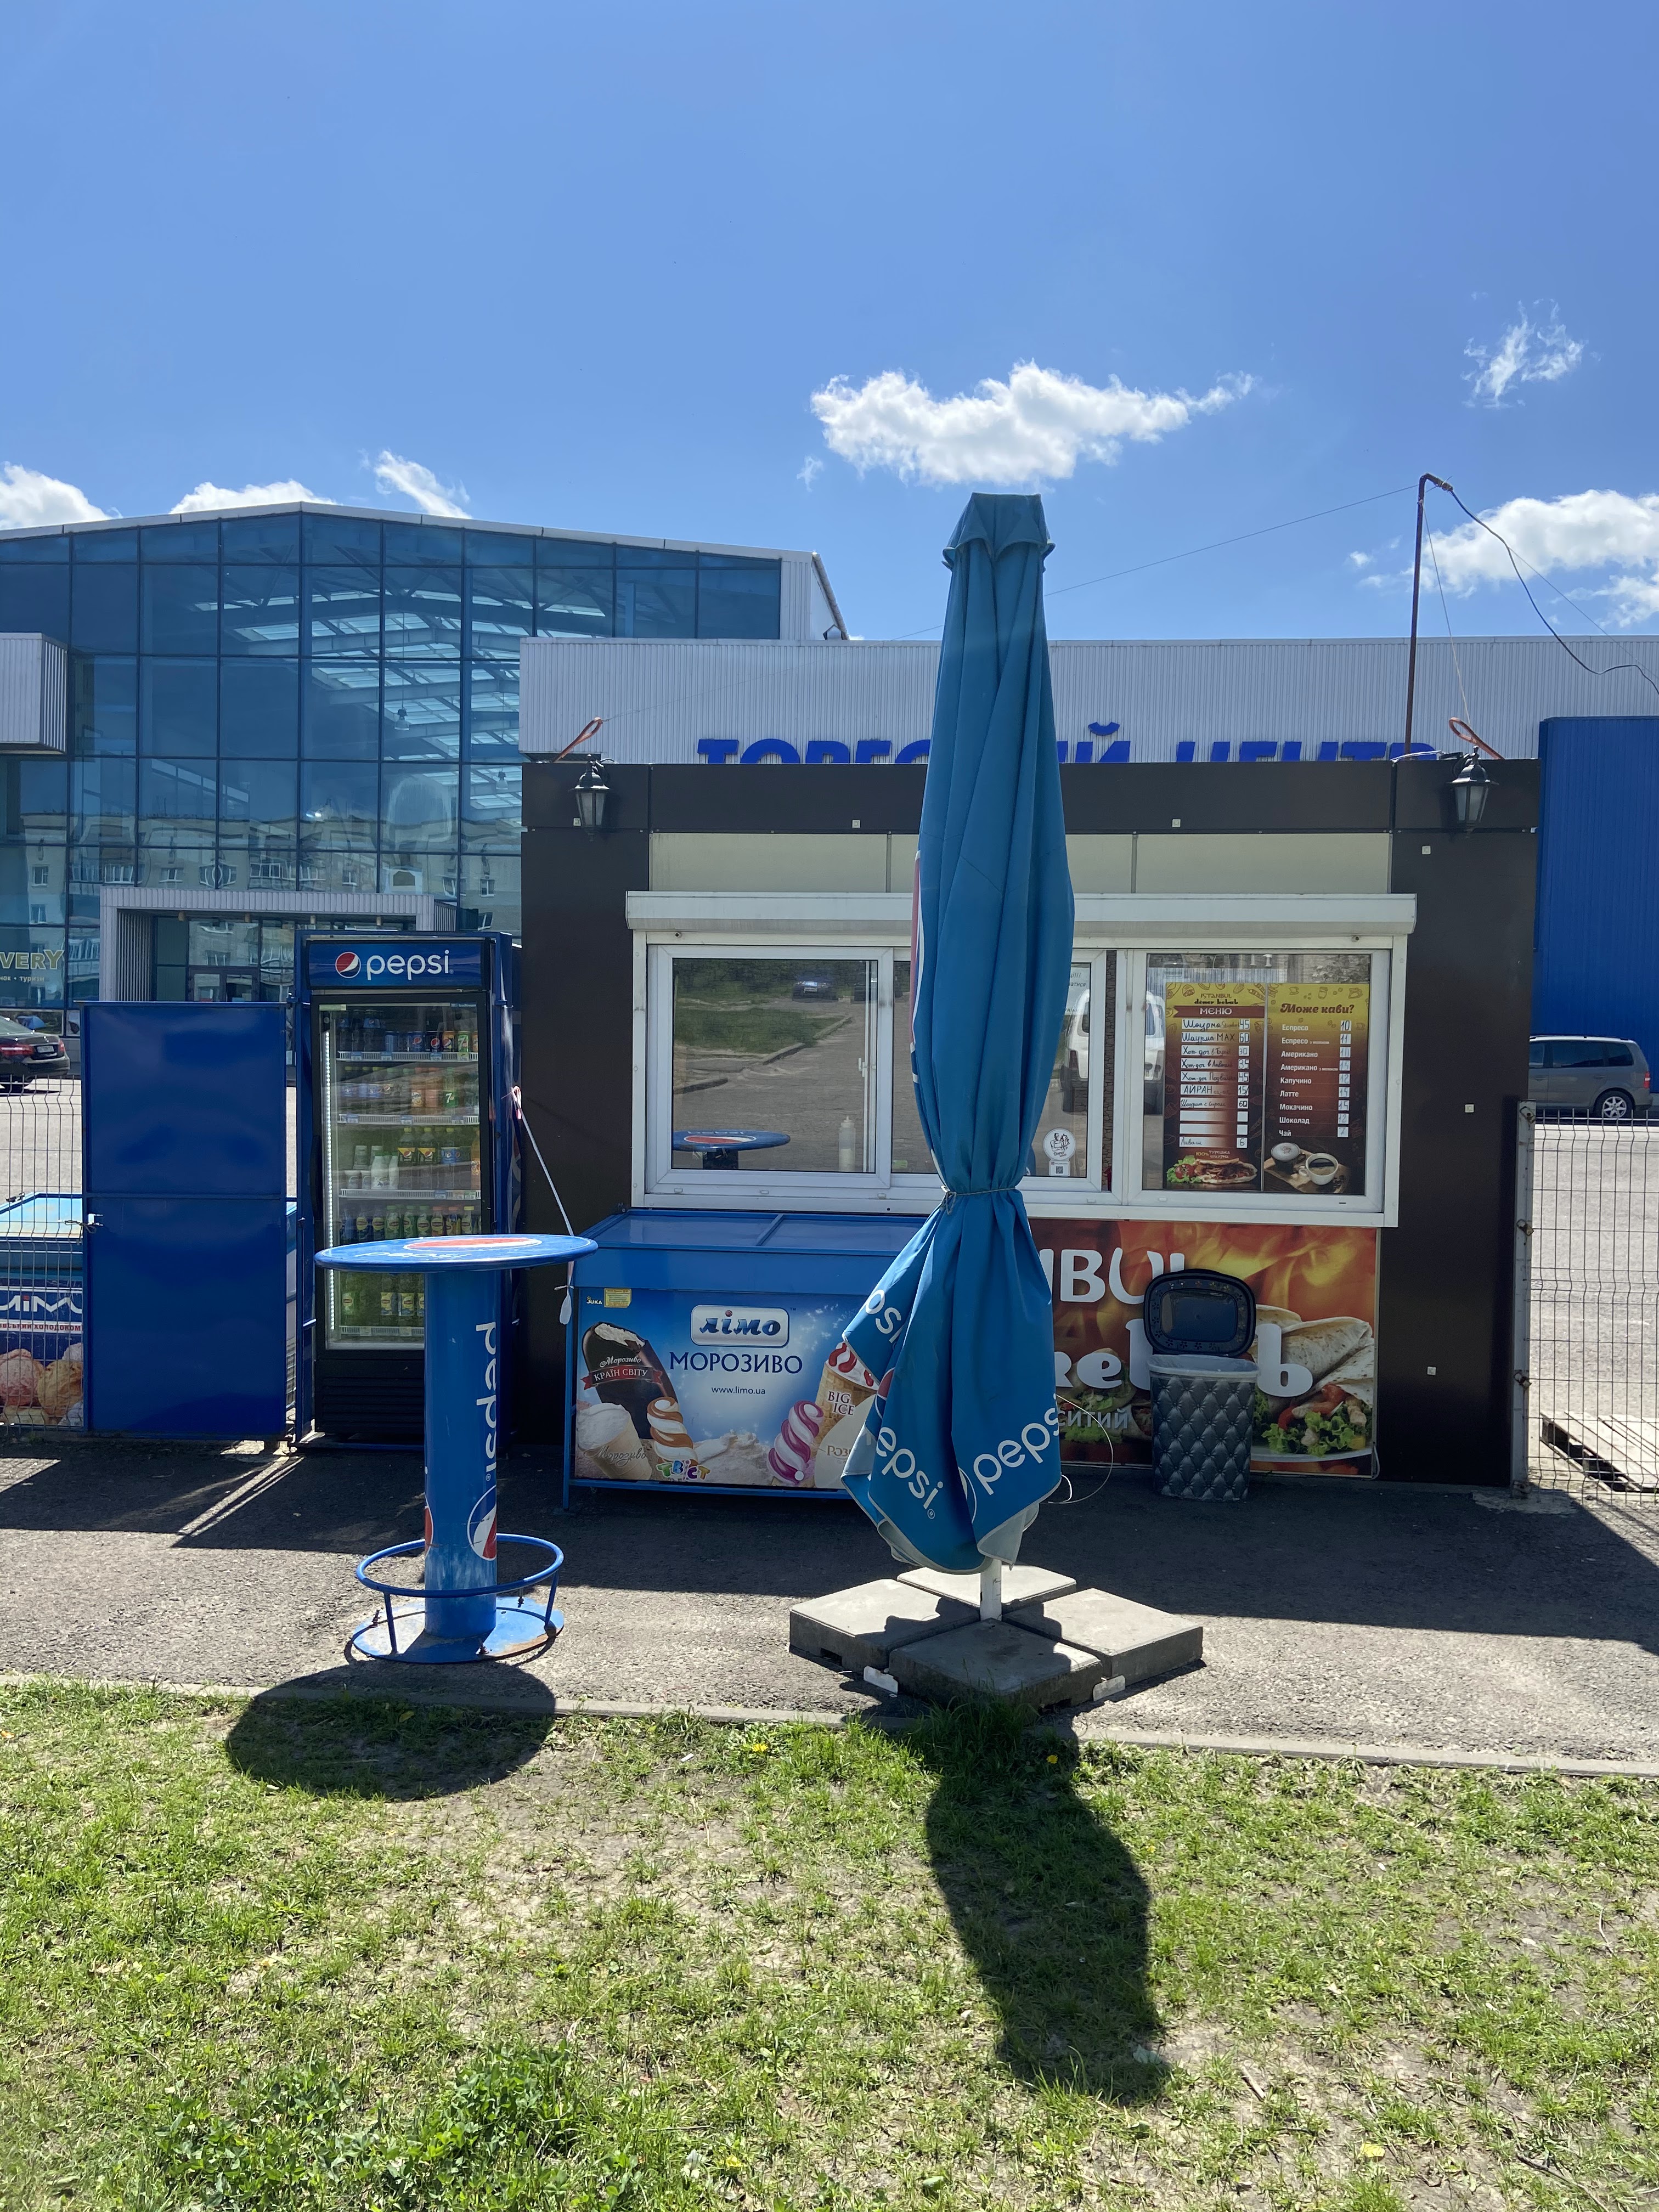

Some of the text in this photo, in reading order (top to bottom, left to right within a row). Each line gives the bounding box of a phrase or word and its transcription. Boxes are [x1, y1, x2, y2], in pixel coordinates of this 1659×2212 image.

[367, 950, 449, 980] pepsi
[1280, 1003, 1355, 1014] Може кави?
[1239, 1019, 1250, 1030] 45
[1282, 1020, 1350, 1032] Еспресо 10
[1239, 1032, 1249, 1042] 60
[1282, 1037, 1308, 1045] Еспресо
[1281, 1051, 1318, 1059] Американо
[1239, 1059, 1249, 1069] 35
[1280, 1064, 1318, 1072] Американо
[1238, 1072, 1249, 1082] 45
[1280, 1077, 1312, 1085] Капучино
[1183, 1084, 1212, 1094] АЙРАН
[1279, 1116, 1310, 1125] Шоколад
[1239, 1138, 1245, 1147] 6
[699, 1310, 781, 1336] лімо
[599, 1355, 642, 1368] Морозиво
[669, 1351, 803, 1374] МОРОЗИВО
[594, 1368, 648, 1381] КРАЇН СВІТУ
[712, 1386, 766, 1395] www.limo.ua
[827, 1391, 851, 1404] BIG
[832, 1402, 855, 1415] ICE
[583, 1445, 647, 1468] Морозиво
